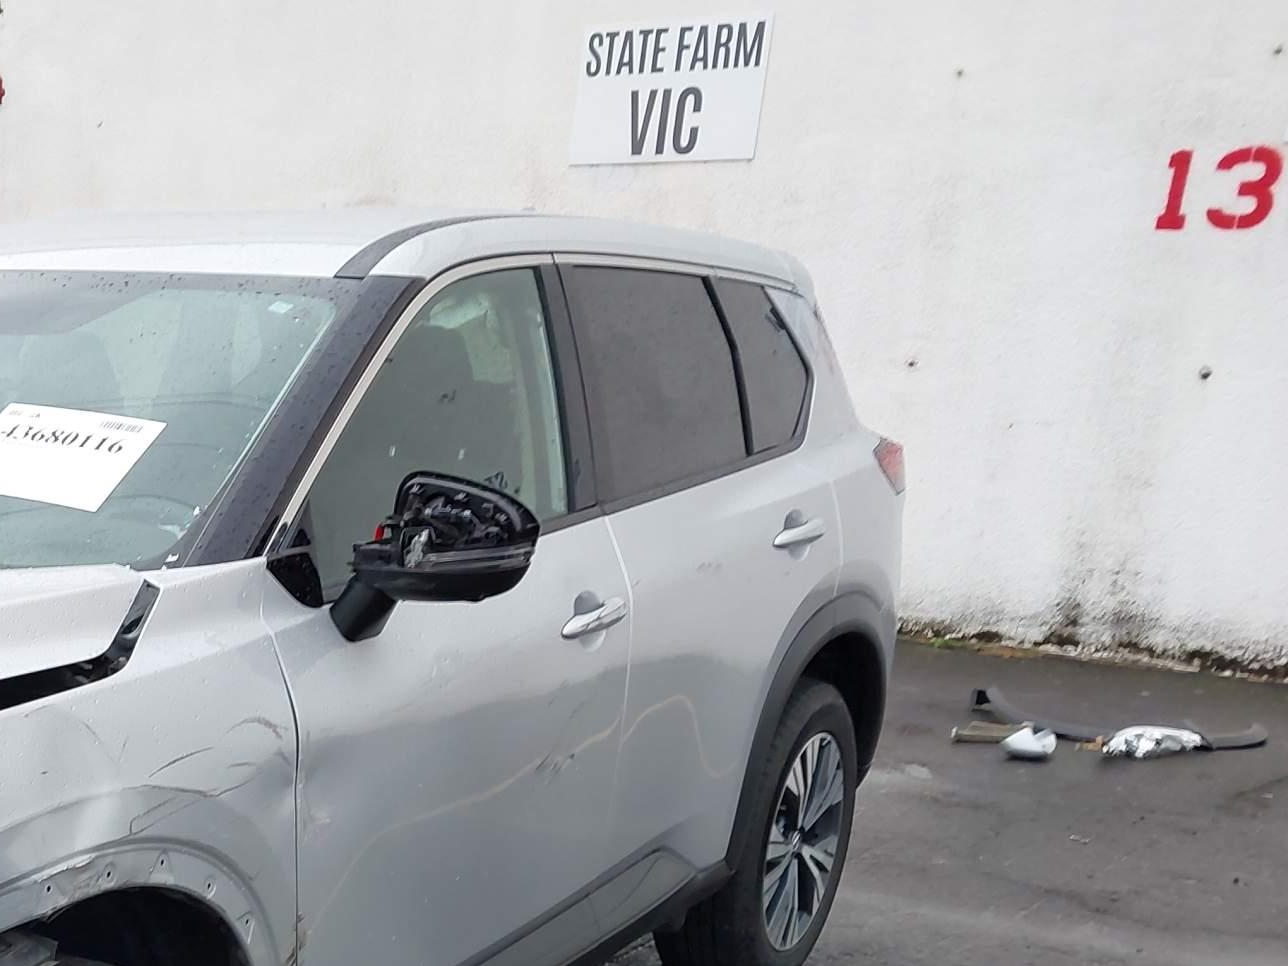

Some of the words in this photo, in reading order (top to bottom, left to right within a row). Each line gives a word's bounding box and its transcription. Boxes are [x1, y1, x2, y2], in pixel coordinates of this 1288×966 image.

[586, 28, 669, 77] STATE
[675, 20, 766, 72] FARM
[630, 86, 703, 156] VIC
[1155, 146, 1283, 230] 13
[1, 423, 123, 453] 43680116
